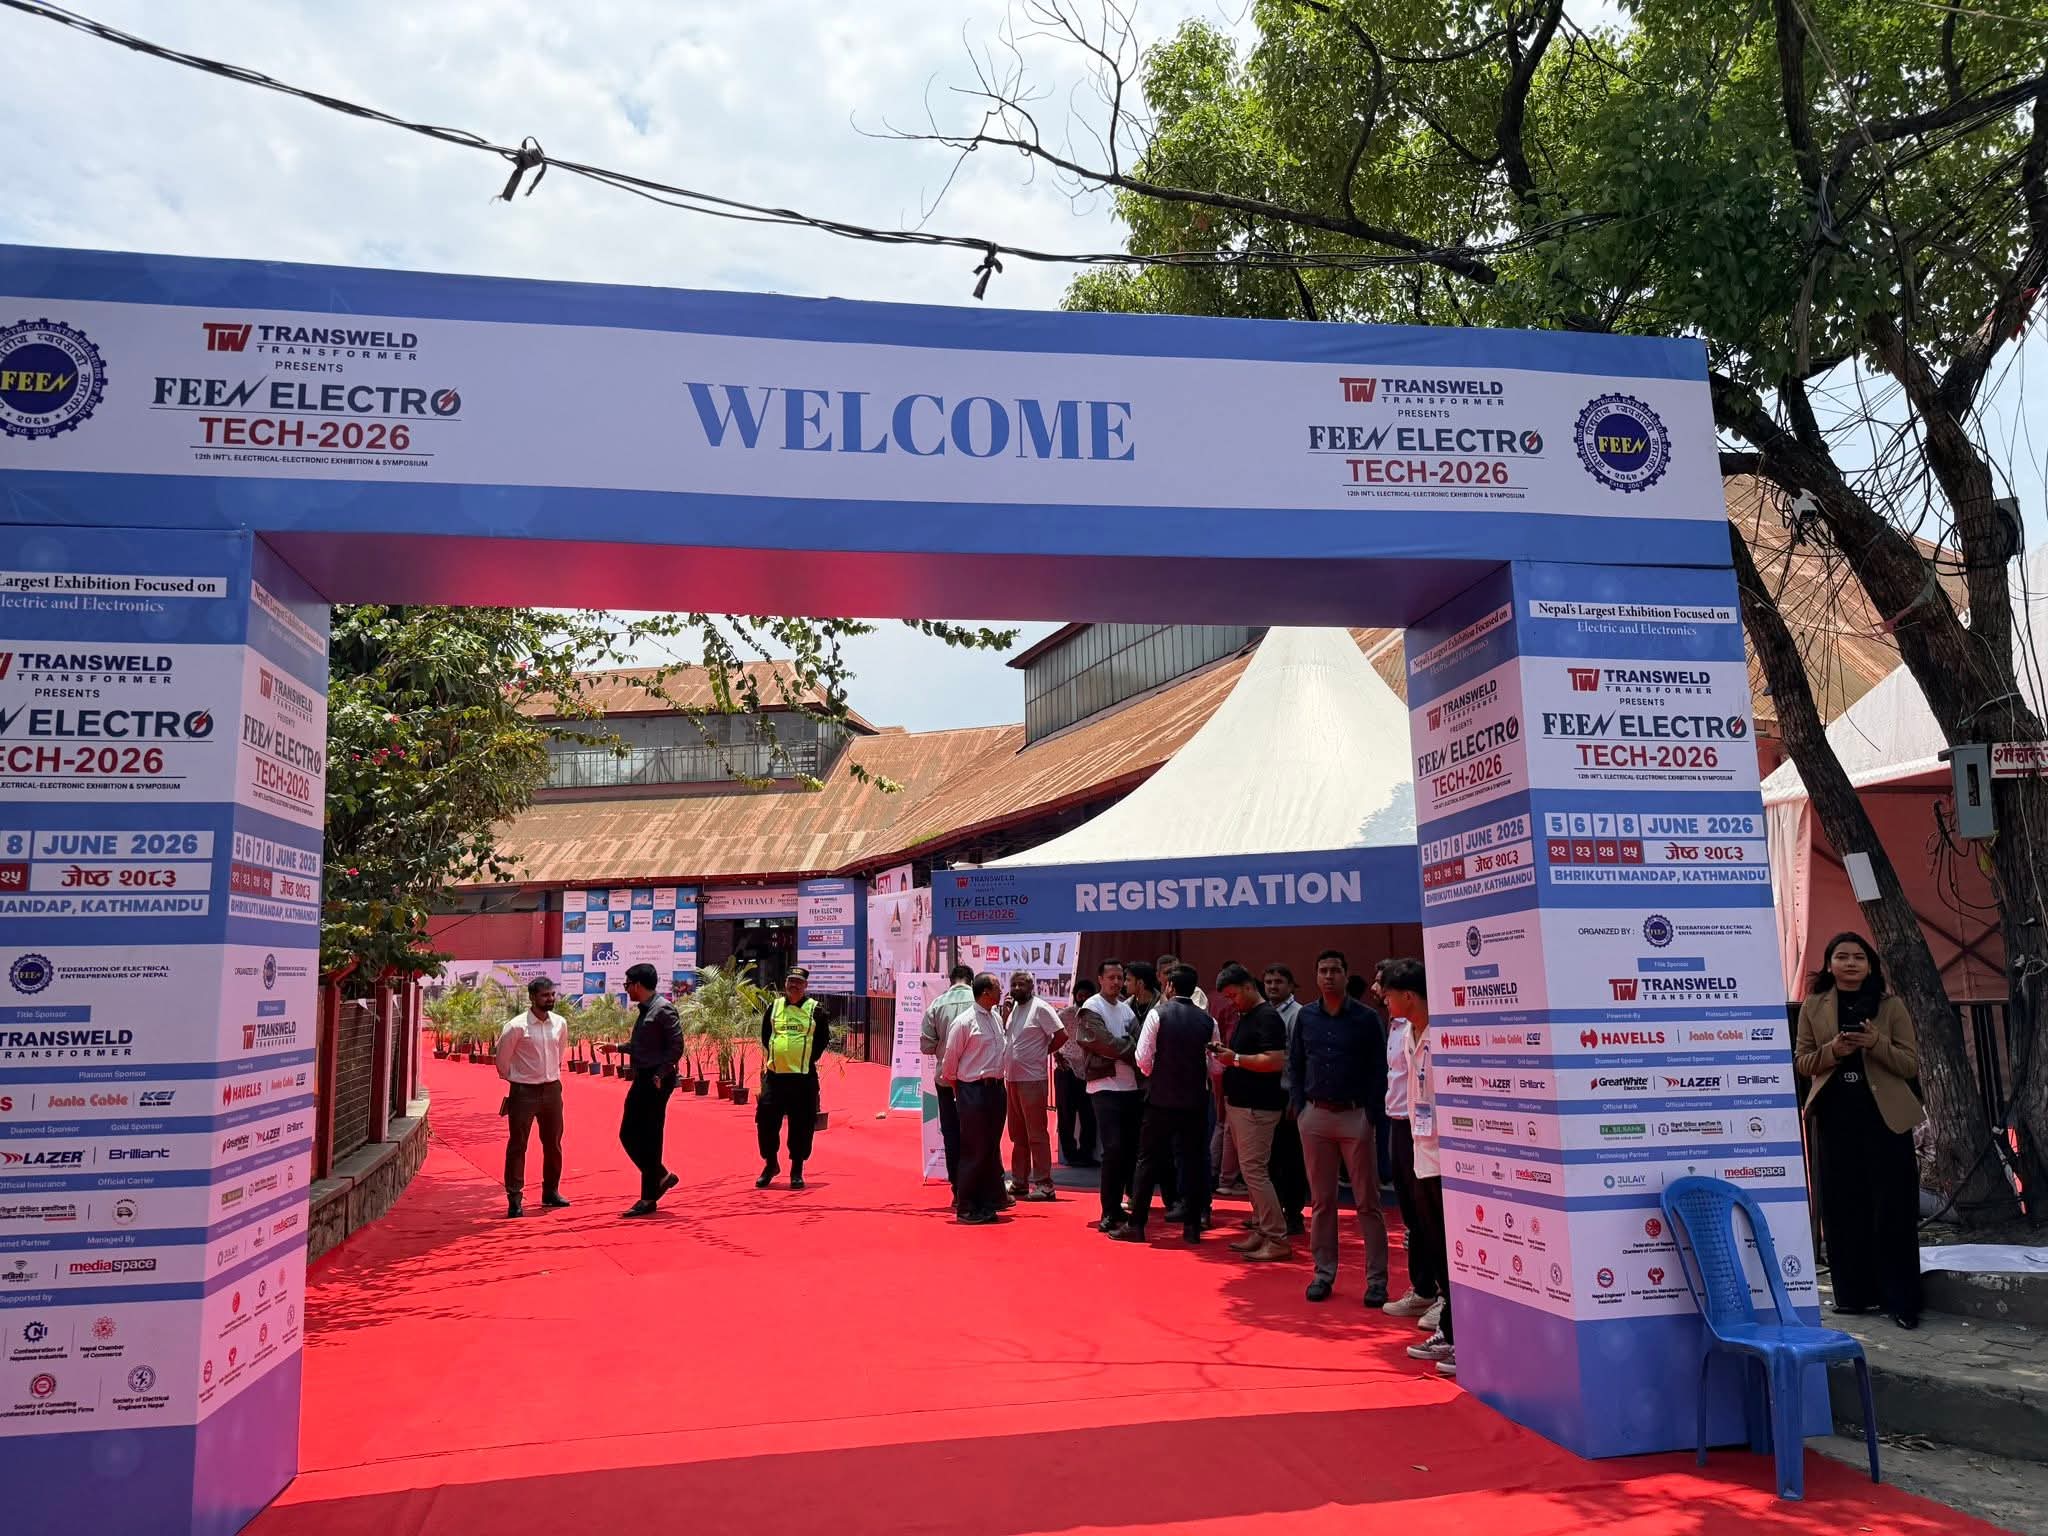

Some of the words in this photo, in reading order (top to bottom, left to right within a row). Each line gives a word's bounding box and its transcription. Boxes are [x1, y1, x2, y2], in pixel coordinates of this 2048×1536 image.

[258, 325, 418, 349] TRANSWELD
[257, 345, 417, 361] TRANSFORMER
[275, 360, 343, 373] PRESENTS
[0, 371, 76, 391] FEEN
[1382, 378, 1503, 395] TRANSWELD
[154, 376, 268, 407] FEEN
[270, 382, 462, 416] ELECTRO
[1383, 395, 1504, 406] TRANSFORMER
[683, 382, 1135, 461] WELCOME
[1398, 409, 1449, 419] PRESENTS
[199, 416, 410, 450] TECH-2026
[1308, 422, 1393, 450] FEEN
[1398, 428, 1544, 455] ELECTRO
[1598, 435, 1648, 453] FEEN
[234, 455, 328, 464] ELECTRICAL-ELECTRONIC
[1346, 459, 1508, 485] TECH-2026
[54, 575, 130, 591] Exhibition
[134, 577, 195, 592] Focused
[198, 582, 216, 593] on
[51, 597, 79, 610] and
[83, 597, 163, 612] Electronics
[1539, 603, 1575, 618] Nepal's
[1578, 605, 1615, 618] Largest
[1618, 606, 1671, 619] Exhibition
[1674, 608, 1714, 619] Focused
[1715, 611, 1729, 619] on
[1577, 622, 1617, 633] Electric
[1618, 623, 1638, 634] and
[1640, 624, 1696, 636] Electronics
[19, 653, 172, 671] TRANSWELD
[17, 673, 171, 683] TRANSFORMER
[1604, 669, 1710, 684] TRANSWELD
[35, 688, 100, 698] PRESENTS
[274, 678, 313, 712] TRANSWELD
[1442, 679, 1497, 715] TRANSWELD
[1606, 686, 1712, 694] TRANSFORMER
[1619, 697, 1664, 706] PRESENTS
[29, 709, 214, 739] ELECTRO
[1542, 710, 1616, 736] FEEN
[1620, 712, 1747, 739] ELECTRO
[1452, 714, 1519, 763] ELECTRO
[275, 731, 322, 775] ELECTRO
[1576, 744, 1718, 768] TECH-2026
[1994, 744, 2048, 767] शौचाल
[256, 757, 309, 800] TECH-2026
[1432, 754, 1502, 797] TECH-2026
[1551, 817, 1562, 832] 5
[1574, 818, 1585, 833] 6
[1599, 818, 1609, 833] 7
[1623, 818, 1634, 834] 8
[1648, 818, 1698, 834] JUNE
[1708, 817, 1753, 834] 2026
[1466, 830, 1492, 850] JUNE
[1496, 819, 1524, 841] 2026
[7, 835, 23, 854] 8
[42, 835, 117, 855] JUNE
[131, 834, 198, 855] 2026
[276, 848, 296, 869] JUNE
[1704, 847, 1744, 861] २०८३
[119, 869, 176, 887] २०८३
[1484, 871, 1532, 892] KATHMANDU
[1683, 871, 1766, 881] KATHMANDU
[1075, 871, 1362, 913] REGISTRATION
[81, 897, 203, 913] KATHMANDU
[975, 895, 1028, 907] ELECTRO
[957, 909, 1015, 920] TECH-2026
[597, 951, 619, 961] C&S
[1467, 982, 1517, 998] TRANSWELD
[1641, 977, 1737, 990] TRANSWELD
[257, 1021, 296, 1038] TRANSWELD
[1751, 1028, 1775, 1036] KEI
[0, 1030, 133, 1046] TRANSWELD
[1450, 1035, 1481, 1047] HAVELLS
[1601, 1031, 1665, 1045] HAVELLS
[1488, 1078, 1511, 1089] LAZER
[1600, 1077, 1648, 1086] GreatWhite
[1680, 1077, 1720, 1087] LAZER
[1738, 1075, 1780, 1085] Brilliant
[90, 1094, 128, 1106] Cable
[11, 1127, 45, 1135] Diamond
[23, 1151, 83, 1164] LAZER
[109, 1149, 170, 1159] Brilliant
[1724, 1166, 1785, 1179] mediaspace
[88, 1236, 124, 1245] Managed
[70, 1258, 156, 1275] mediaspace
